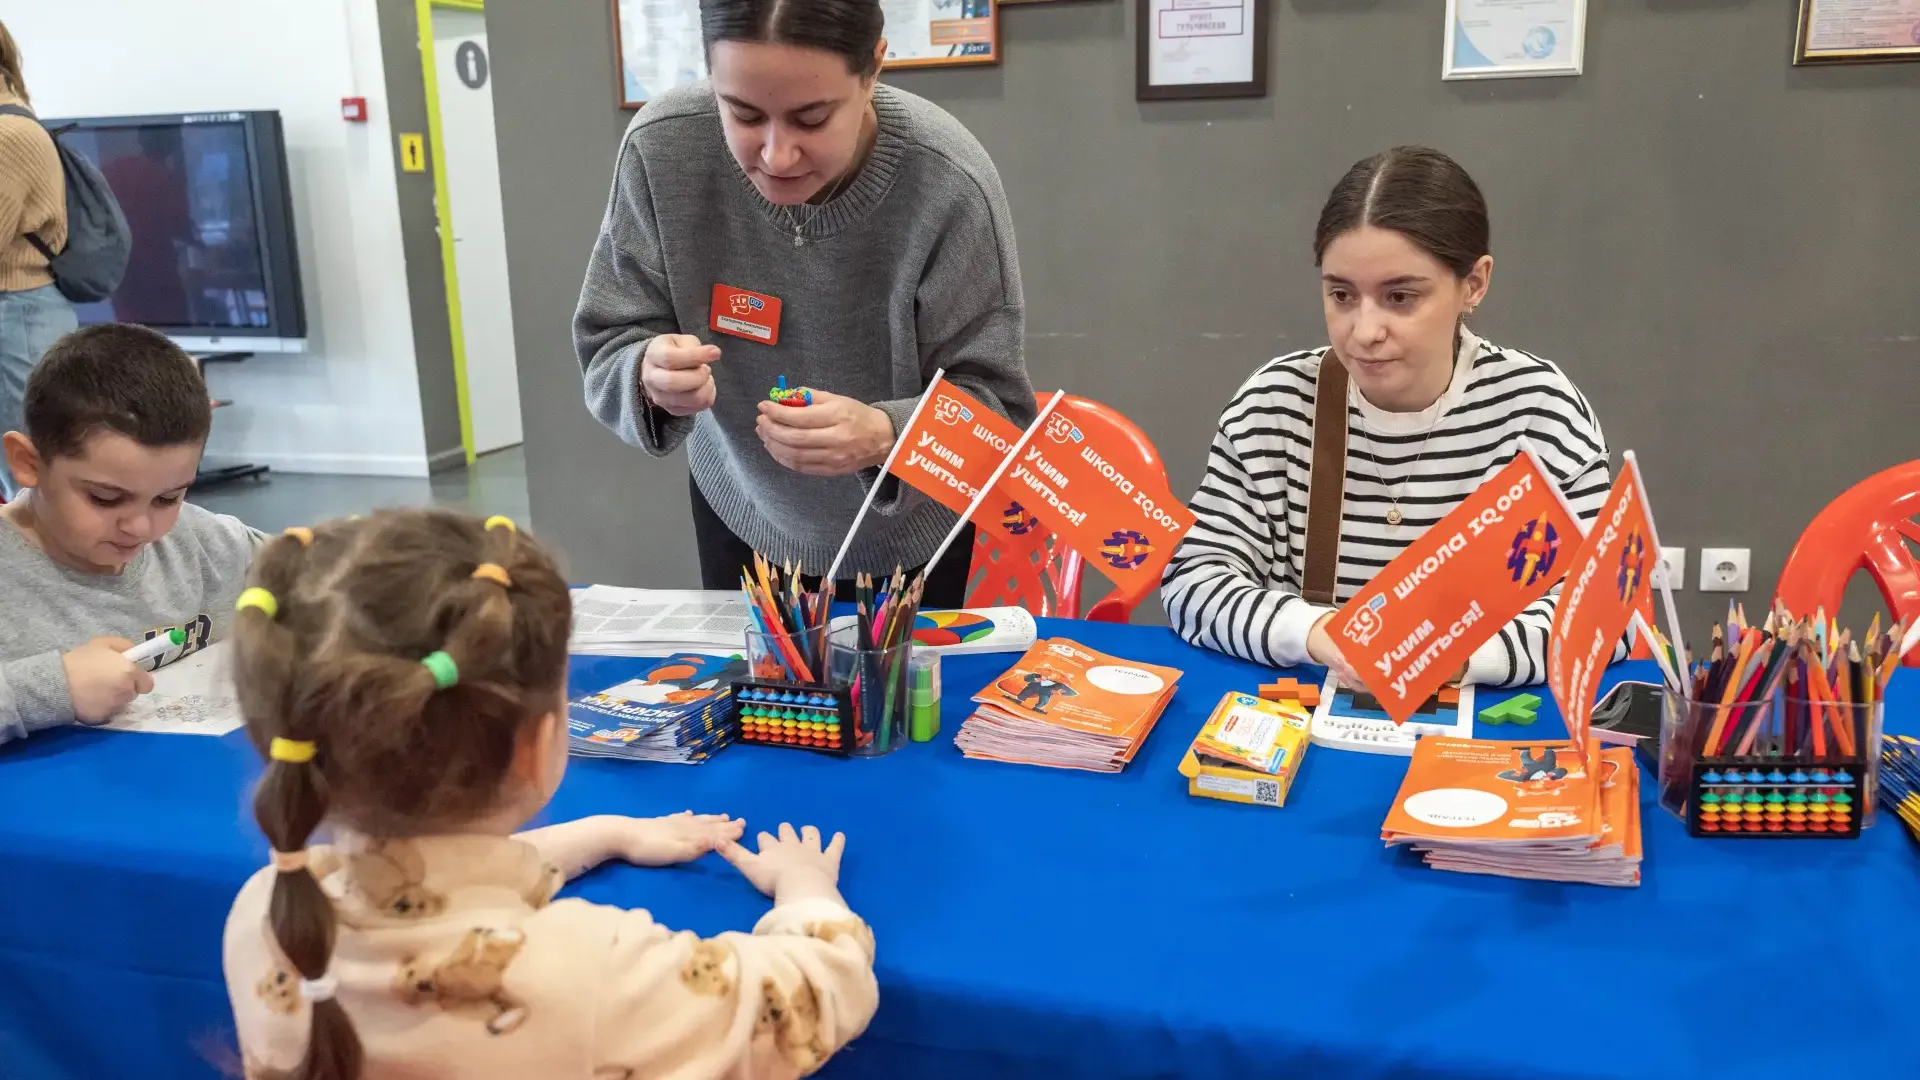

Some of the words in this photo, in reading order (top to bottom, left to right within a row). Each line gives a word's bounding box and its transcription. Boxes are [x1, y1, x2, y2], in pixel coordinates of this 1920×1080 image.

[918, 431, 965, 470] Учим
[972, 424, 1014, 455] школ
[905, 450, 981, 500] учиться
[1025, 445, 1070, 490] Учим
[1010, 463, 1088, 527] учиться!
[1374, 619, 1435, 677] Учим
[1390, 600, 1485, 700] учиться!
